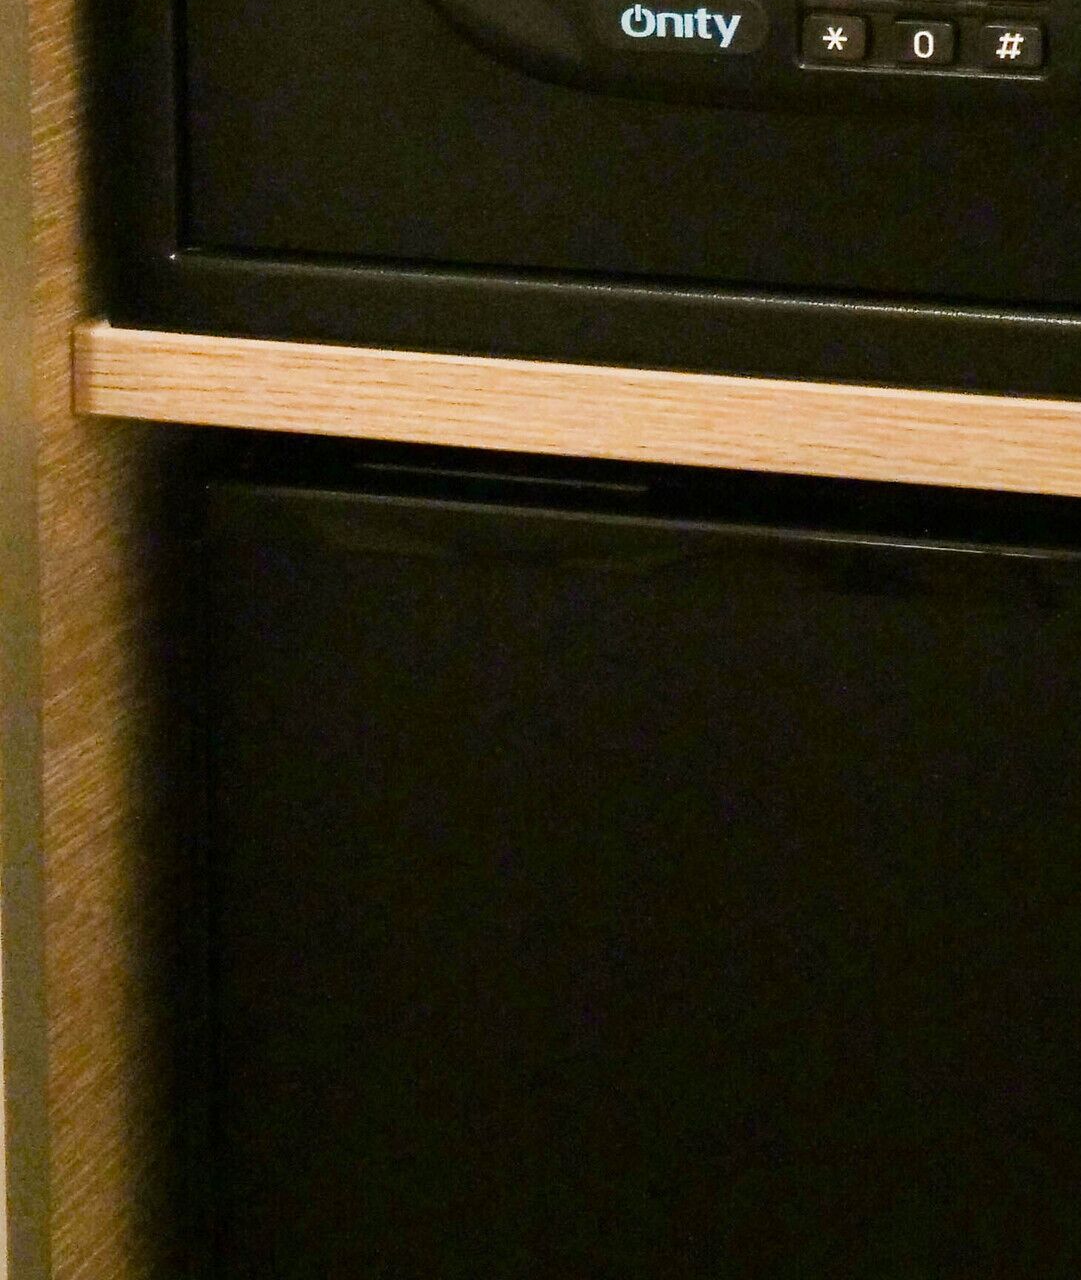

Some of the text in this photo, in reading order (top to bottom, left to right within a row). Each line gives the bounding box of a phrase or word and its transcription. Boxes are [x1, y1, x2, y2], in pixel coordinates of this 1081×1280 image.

[621, 3, 742, 48] Onity
[913, 31, 935, 59] 0
[995, 33, 1024, 59] #
